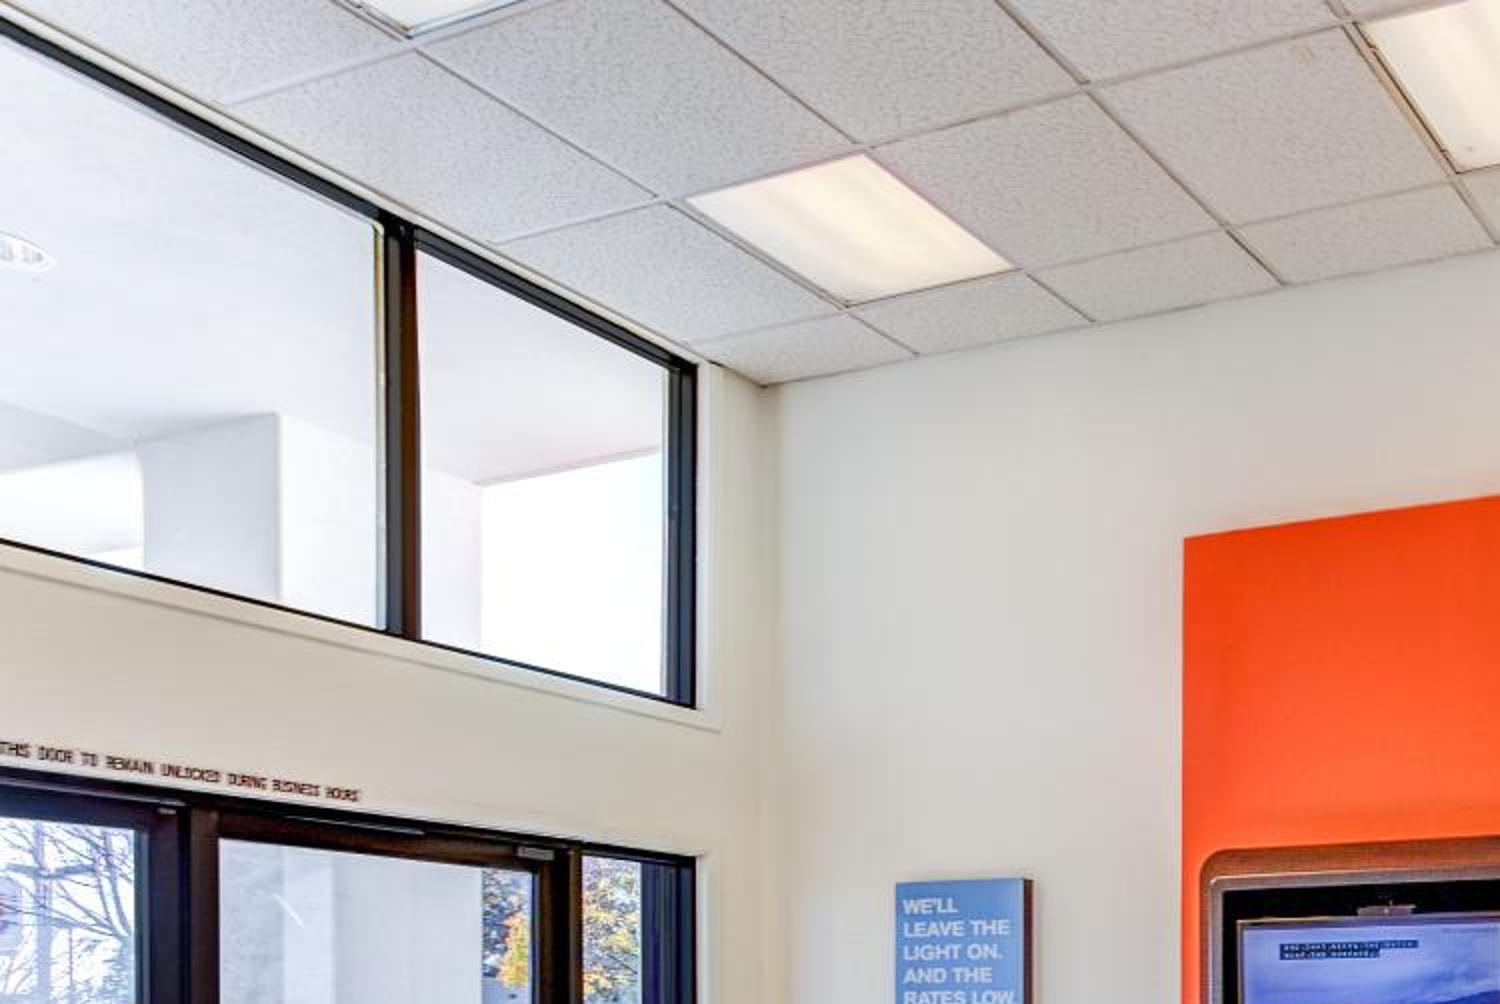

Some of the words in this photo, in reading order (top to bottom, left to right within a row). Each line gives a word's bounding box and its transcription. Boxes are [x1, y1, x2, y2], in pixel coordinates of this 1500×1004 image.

[0, 741, 29, 758] THIS
[38, 746, 73, 764] DOOR
[81, 752, 98, 767] TO
[107, 755, 154, 775] REMAIN
[161, 763, 221, 783] UNLOCKED
[228, 772, 268, 791] DURING
[272, 779, 320, 797] BUSINESS
[326, 784, 361, 802] HOURS
[903, 921, 965, 937] LEAVE
[970, 919, 1010, 936] THE
[903, 944, 961, 961] LIGHT
[903, 967, 947, 984] AND
[953, 966, 992, 983] THE
